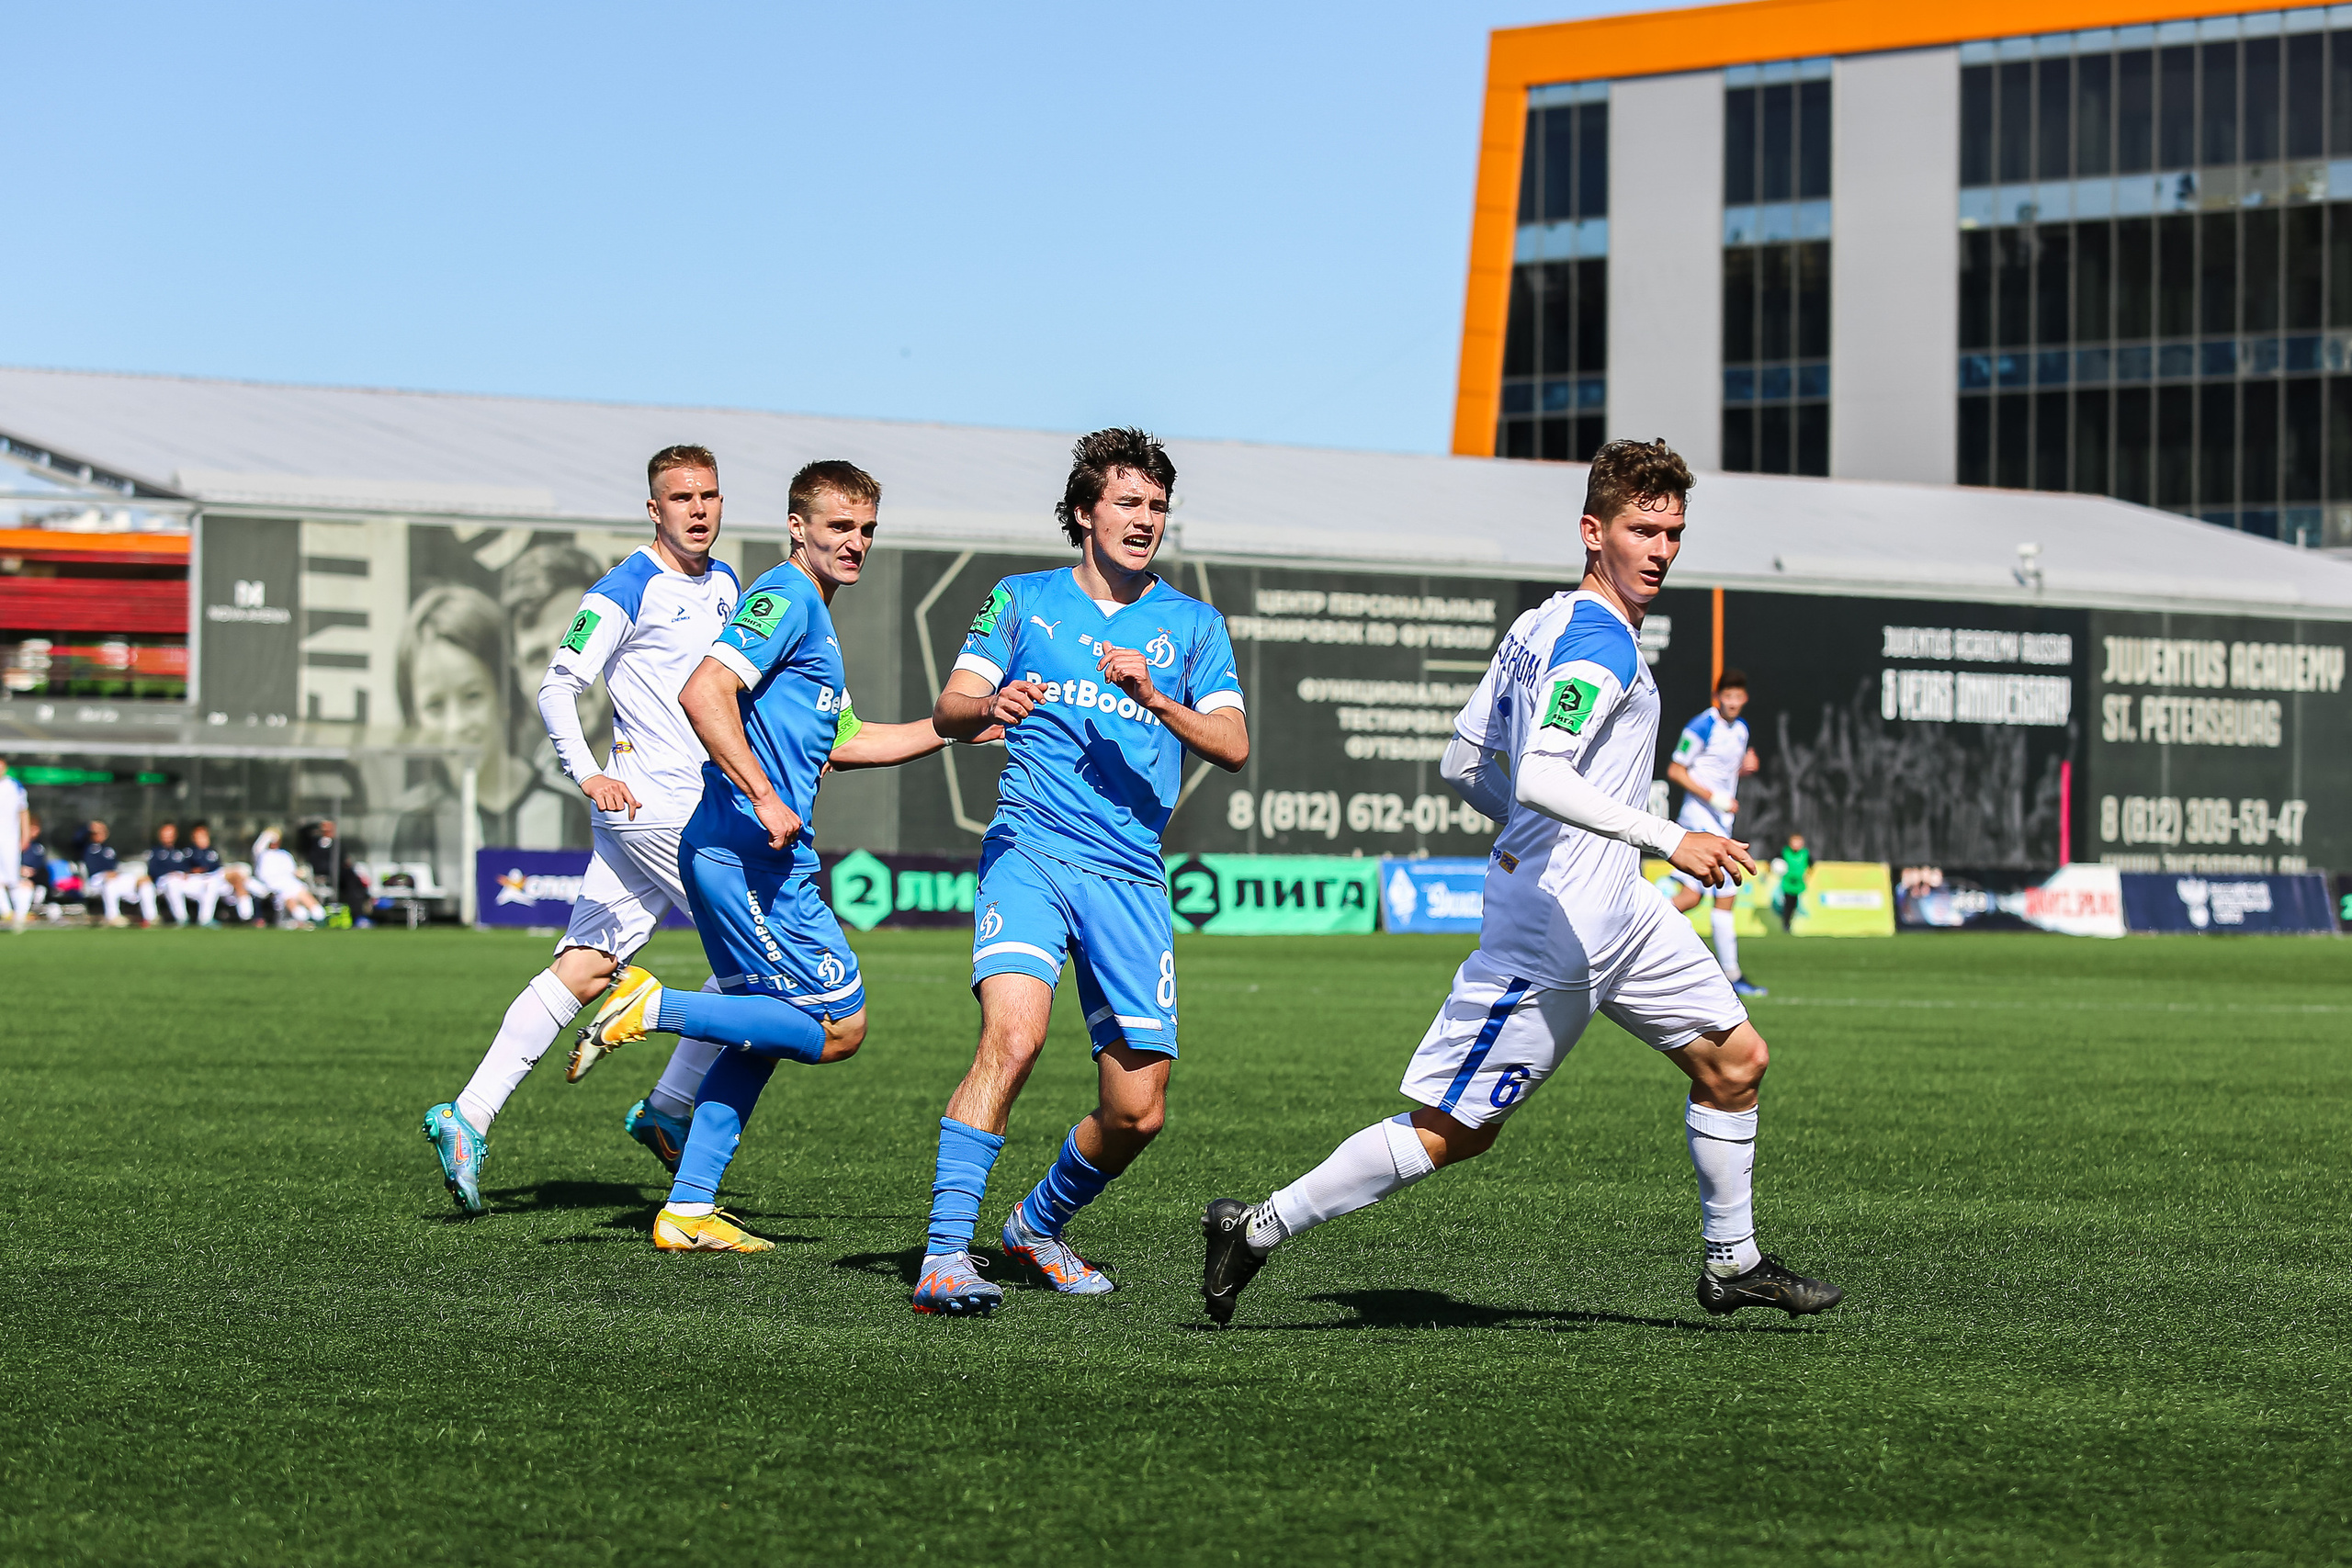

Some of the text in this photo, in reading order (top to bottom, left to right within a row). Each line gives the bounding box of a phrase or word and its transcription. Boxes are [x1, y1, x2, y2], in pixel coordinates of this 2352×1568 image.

[741, 616, 763, 628] ЛИГА
[753, 601, 768, 615] 2
[1255, 589, 1497, 623] ЦЕНТР ПЕРСОНАЛЬНЫХ
[1227, 615, 1497, 650] ТРЕНИРОВОК ПО ФУТБОЛУ
[2101, 635, 2346, 693] JUVENTUS ACADEMY
[2102, 693, 2282, 749] ST. PETERSBURG
[1227, 789, 1255, 830] 8
[1260, 789, 1341, 840] (812)
[2100, 795, 2309, 847] 8 (812) 309-53-47
[845, 874, 876, 906] 2
[1174, 870, 1365, 914] 2 ЛИГА
[1156, 949, 1175, 1009] 8
[1489, 1064, 1531, 1109] 6
